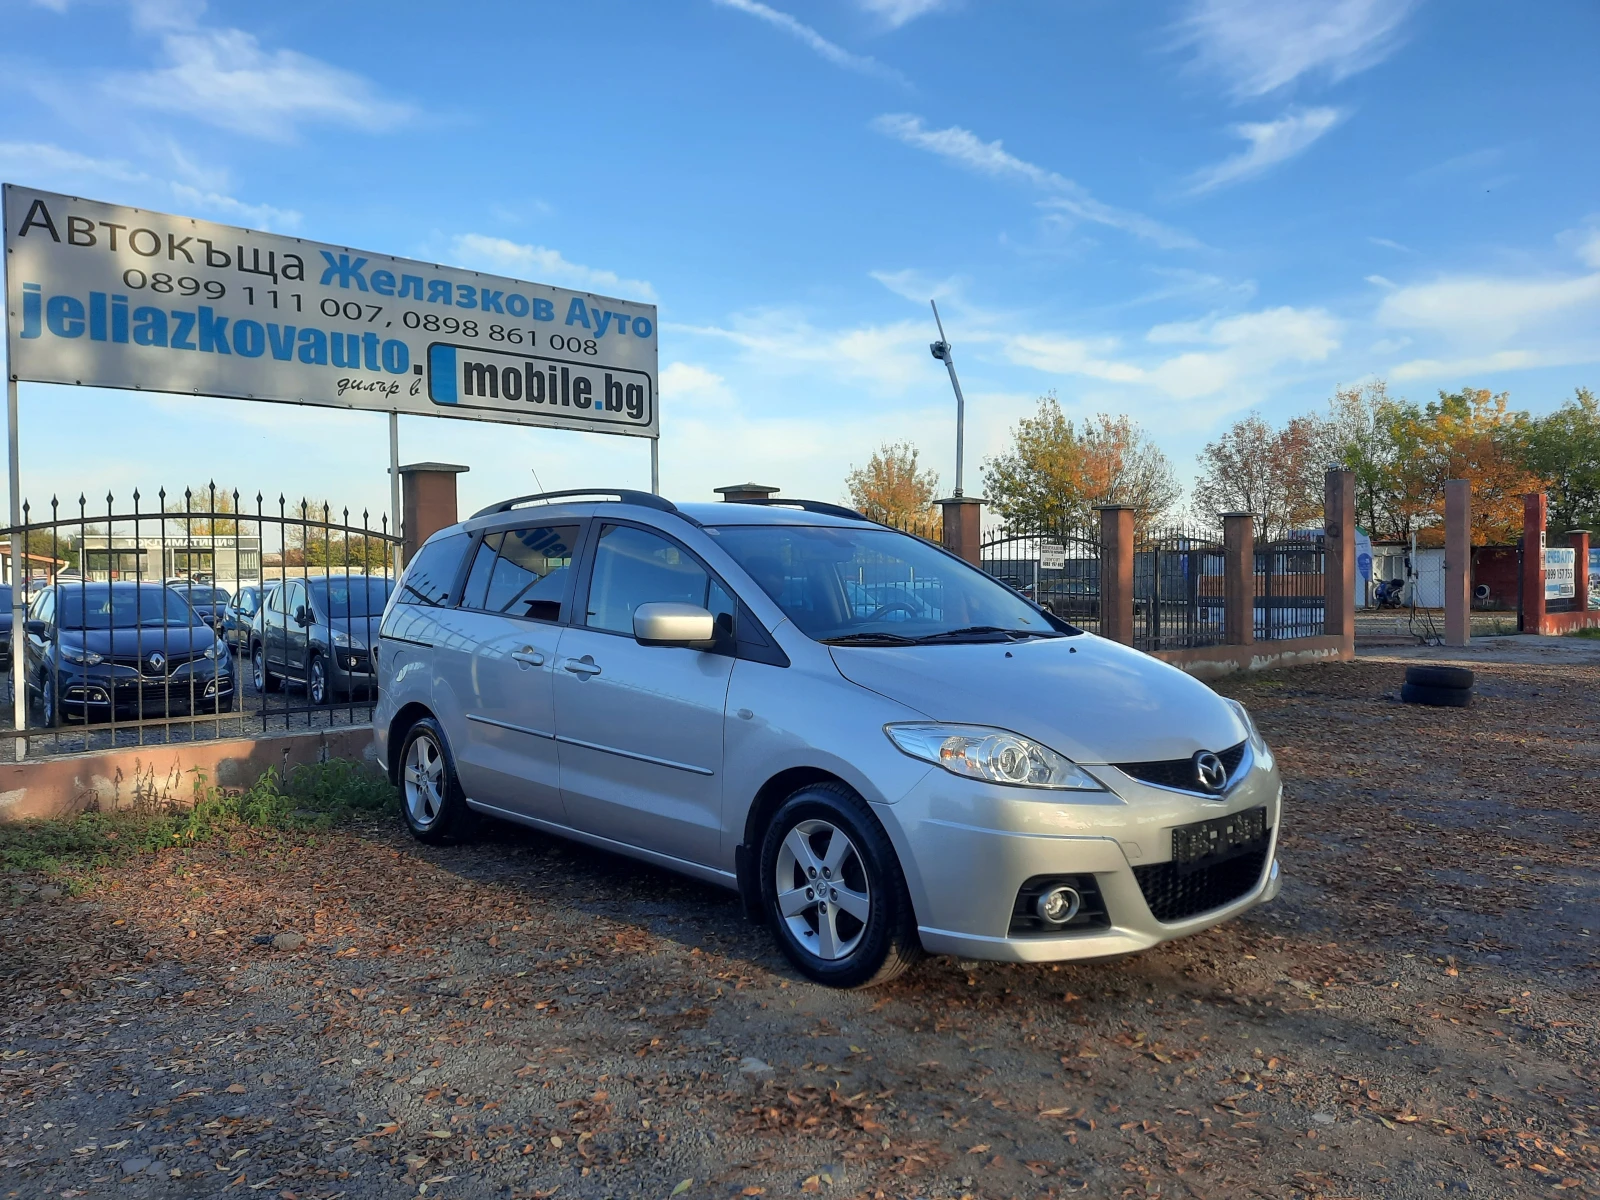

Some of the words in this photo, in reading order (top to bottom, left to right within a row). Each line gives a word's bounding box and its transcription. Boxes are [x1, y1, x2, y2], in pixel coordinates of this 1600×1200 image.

[18, 198, 304, 284] Автокъща
[319, 250, 555, 322] Желязков
[564, 297, 653, 339] Ауто
[122, 268, 227, 300] 0899
[242, 286, 303, 312] 111
[319, 298, 392, 328] 007,
[402, 310, 479, 338] 0898
[488, 324, 537, 347] 861
[549, 333, 598, 356] 008
[337, 377, 400, 399] дилър
[409, 382, 421, 397] в
[463, 360, 645, 419] mobile.bg
